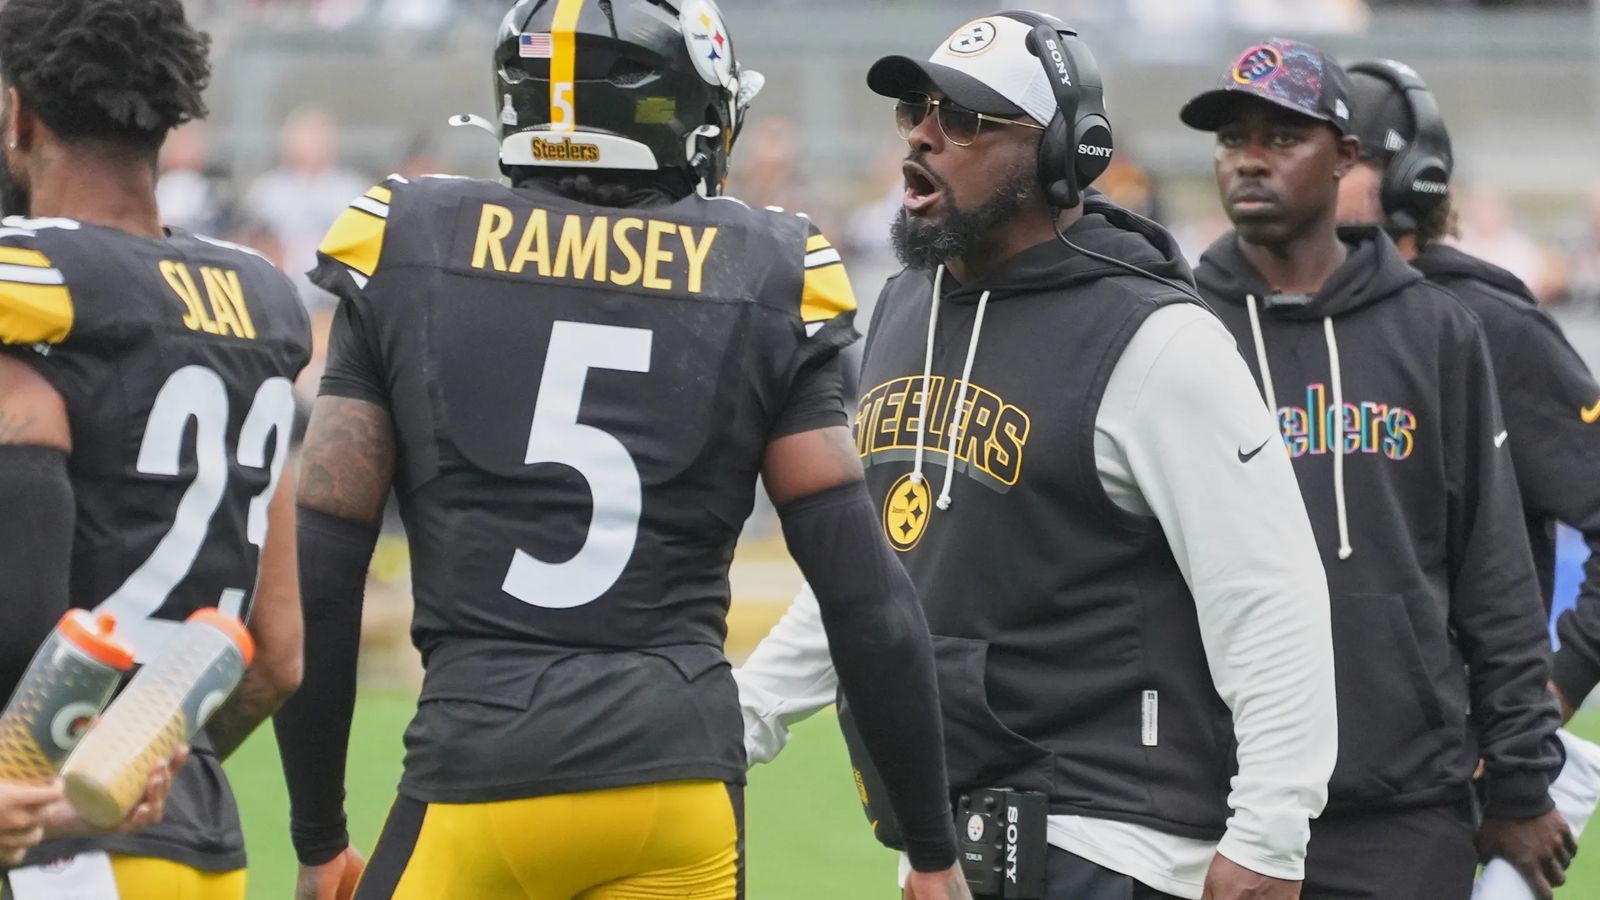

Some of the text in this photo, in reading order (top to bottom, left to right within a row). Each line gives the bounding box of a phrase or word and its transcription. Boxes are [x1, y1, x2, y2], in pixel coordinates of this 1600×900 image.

[1045, 39, 1072, 87] SONY
[551, 82, 573, 131] 5
[531, 137, 600, 162] Steelers
[1078, 143, 1113, 158] SONY
[471, 203, 718, 293] RAMSEY
[159, 260, 256, 339] SLAY
[501, 320, 653, 609] 5
[1006, 806, 1018, 884] SONY
